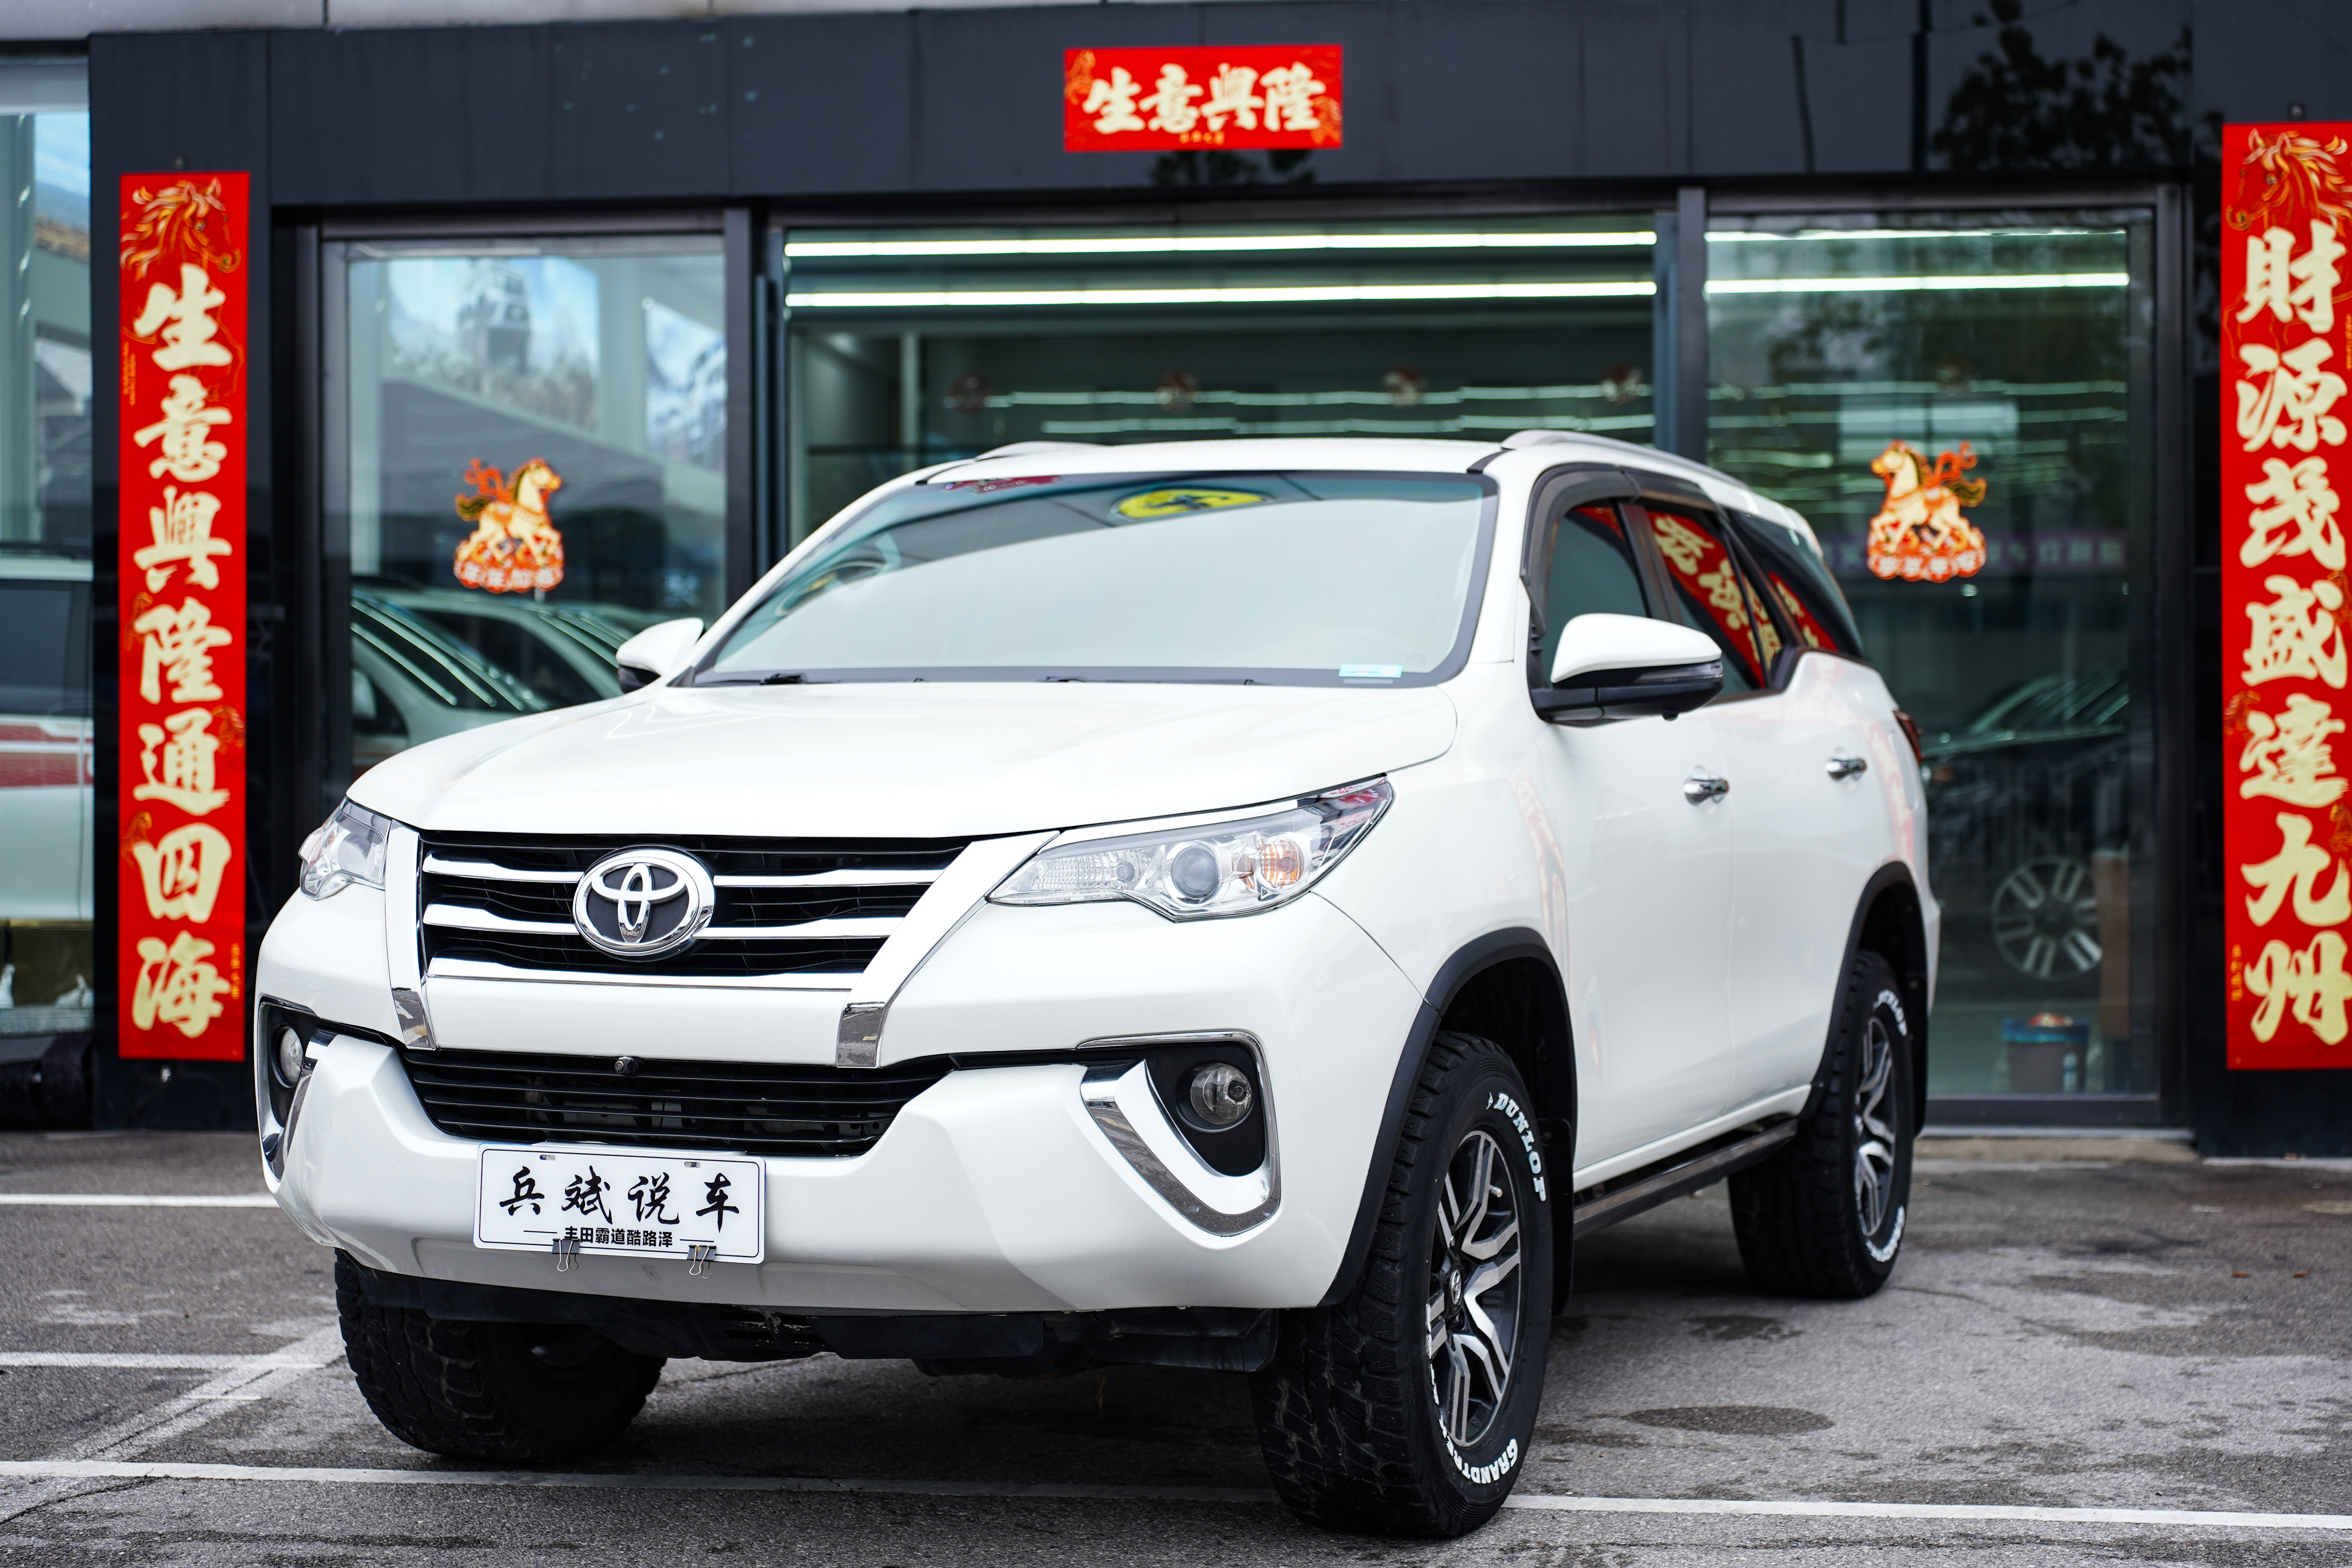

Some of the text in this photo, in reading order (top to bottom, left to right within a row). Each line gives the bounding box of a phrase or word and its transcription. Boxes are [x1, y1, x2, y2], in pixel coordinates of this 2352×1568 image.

[1082, 62, 1326, 134] 生意興隆
[133, 263, 232, 1037] 生意興隆通四海
[2236, 219, 2352, 1045] 財源茂盛達九州
[1493, 1093, 1546, 1202] DUNLOP
[500, 1165, 739, 1233] 兵斌说车
[564, 1226, 673, 1247] 丰田霸道酷路泽
